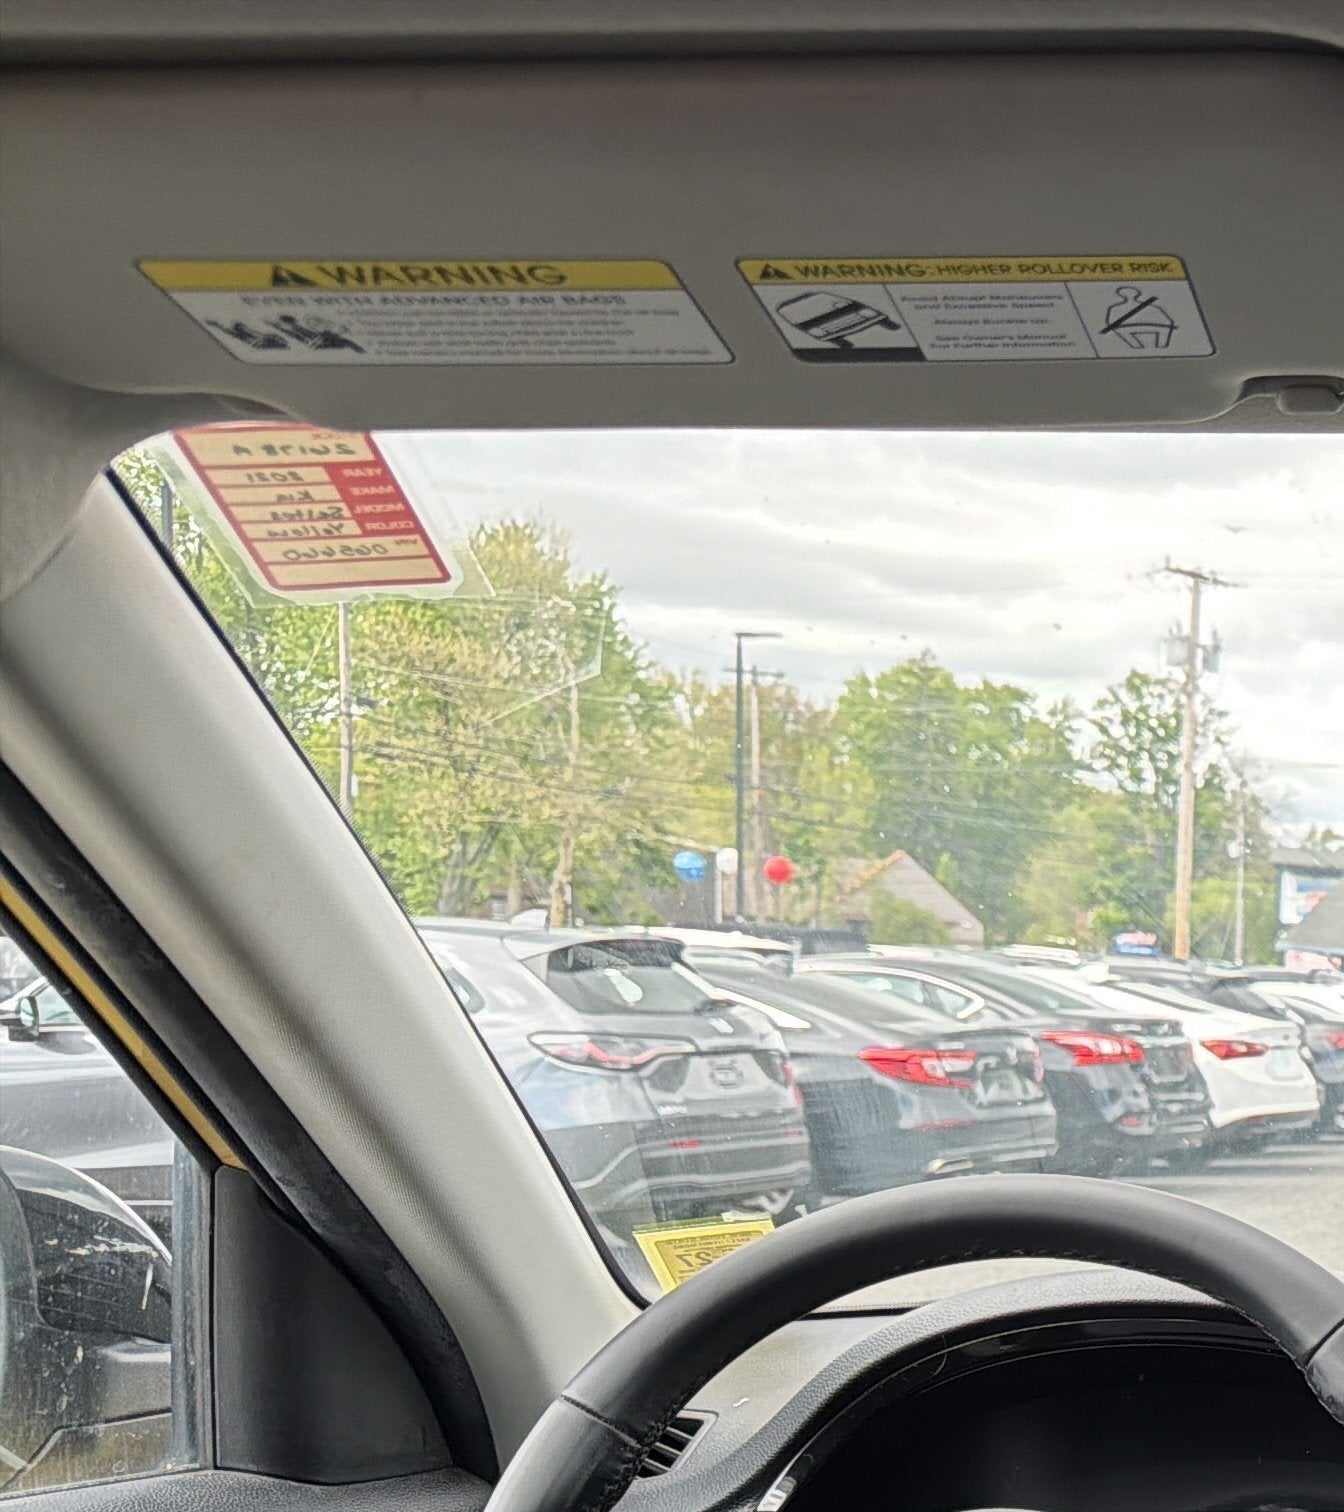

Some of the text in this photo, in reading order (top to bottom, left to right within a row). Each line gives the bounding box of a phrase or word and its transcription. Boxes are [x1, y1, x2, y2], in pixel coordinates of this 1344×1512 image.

[317, 264, 567, 286] WARNING
[937, 264, 1012, 276] HIGHER
[1018, 262, 1124, 275] ROLLOVER
[1131, 261, 1173, 274] RISK
[381, 296, 510, 305] ADVANCED
[519, 295, 555, 305] AIR
[562, 295, 626, 305] BAGS
